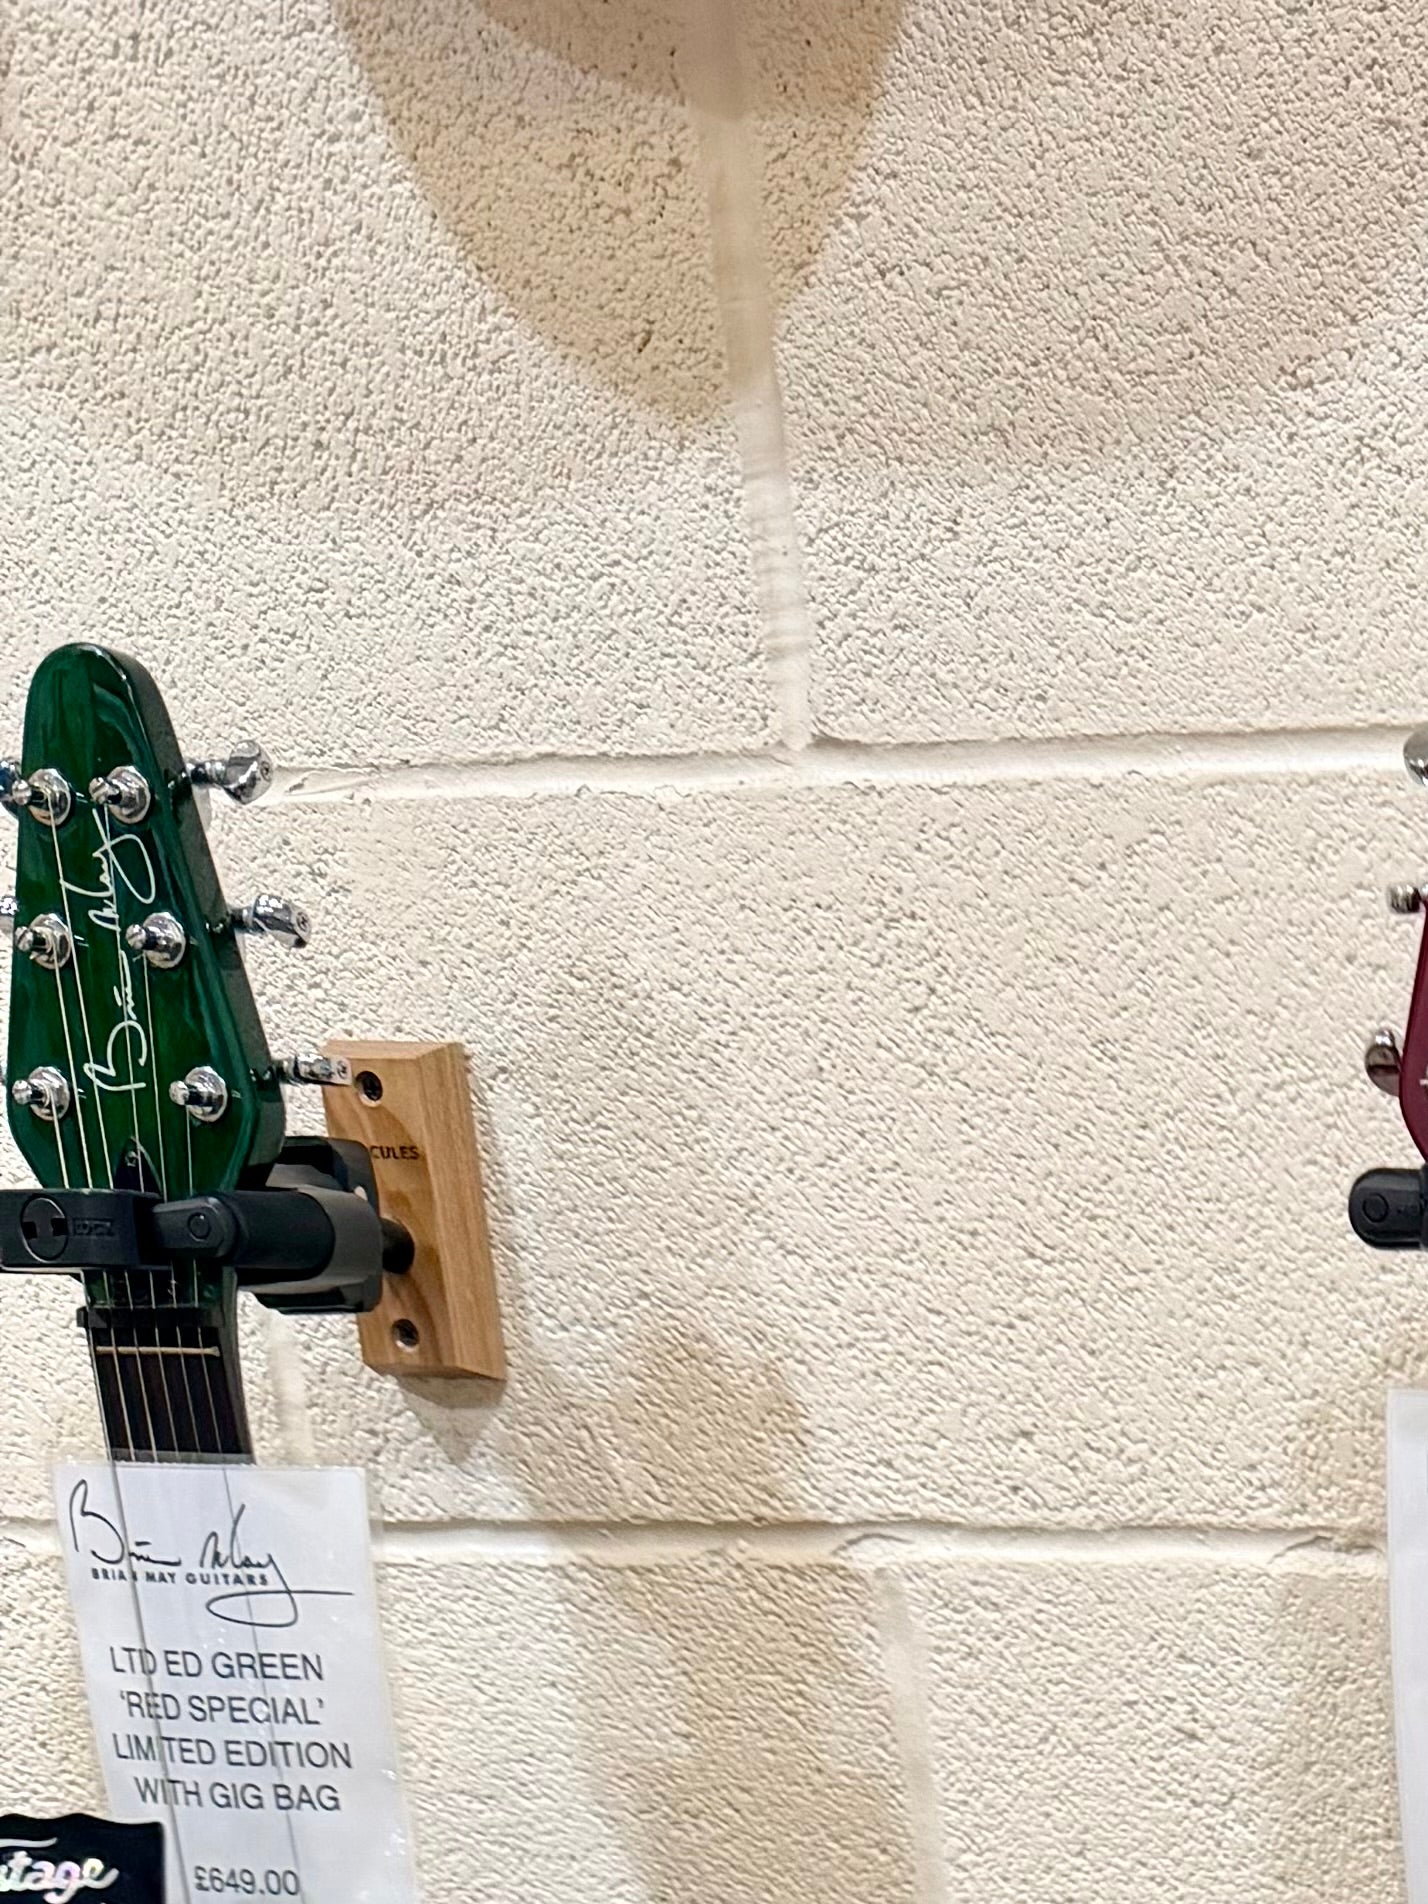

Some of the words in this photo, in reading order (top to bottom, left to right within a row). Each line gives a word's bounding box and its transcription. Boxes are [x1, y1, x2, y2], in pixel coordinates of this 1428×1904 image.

[370, 1145, 420, 1160] CULES
[145, 1570, 176, 1585] MAY
[186, 1571, 269, 1587] GUITARS
[110, 1647, 156, 1676] LTD
[166, 1649, 201, 1678] ED
[212, 1651, 325, 1681] GREEN
[113, 1733, 215, 1766] LIMITED
[226, 1740, 352, 1769] EDITION
[134, 1776, 202, 1809] WITH
[209, 1782, 263, 1810] GIG
[275, 1784, 341, 1811] BAG
[0, 1846, 119, 1904] tage
[194, 1866, 299, 1896] £649.00
